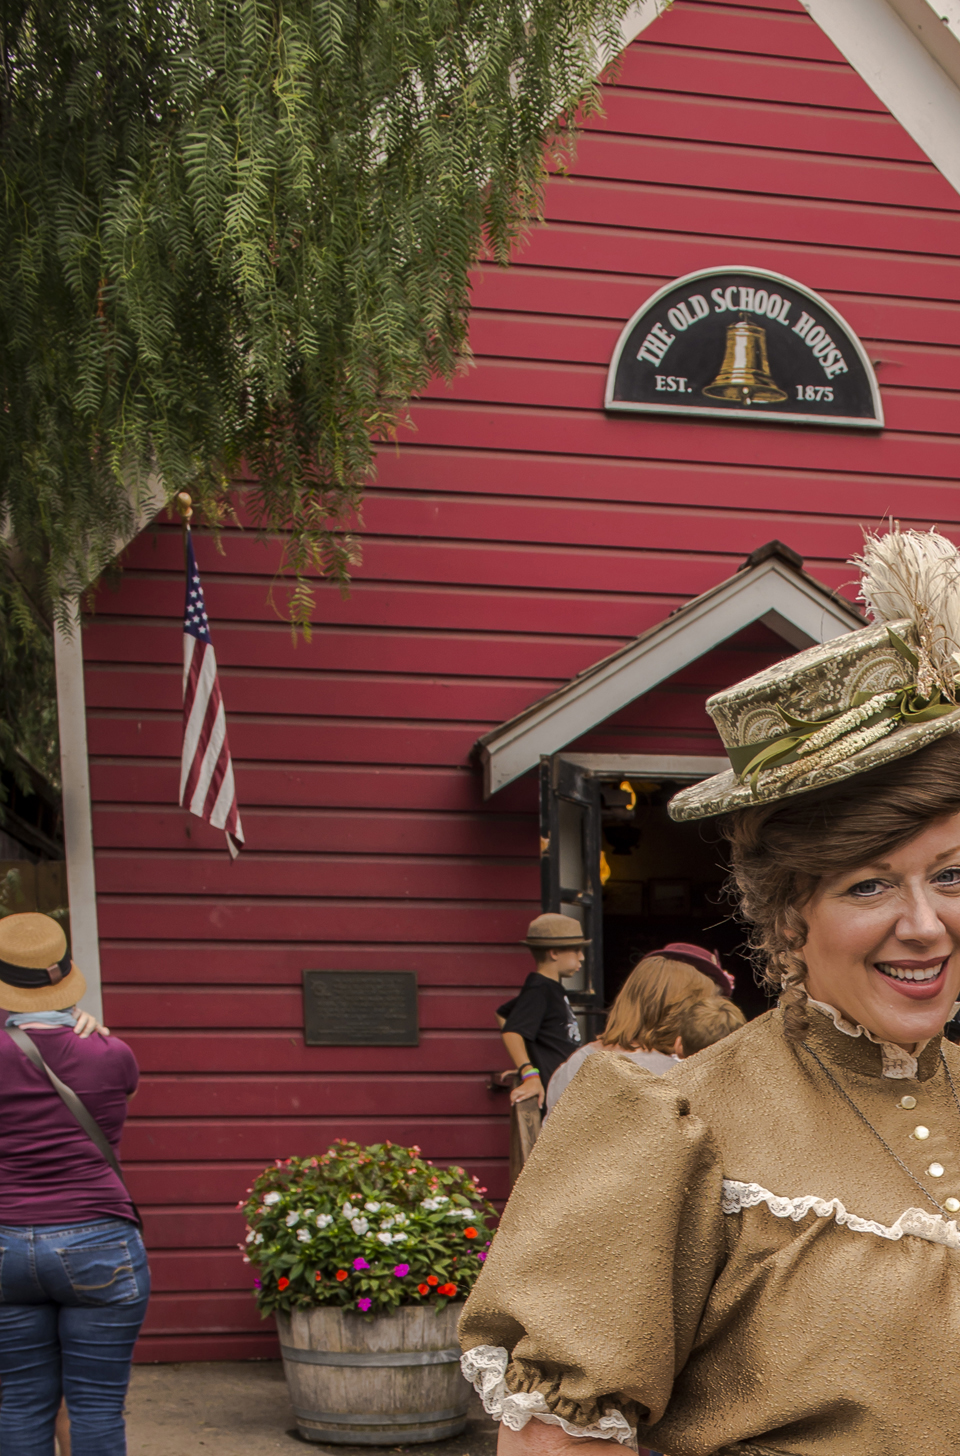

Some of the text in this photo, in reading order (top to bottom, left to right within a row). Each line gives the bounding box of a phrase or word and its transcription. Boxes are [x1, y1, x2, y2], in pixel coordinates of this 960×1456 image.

[636, 286, 849, 380] THE OLD SCHOOL HOUSE
[655, 375, 835, 402] EST. 1875
